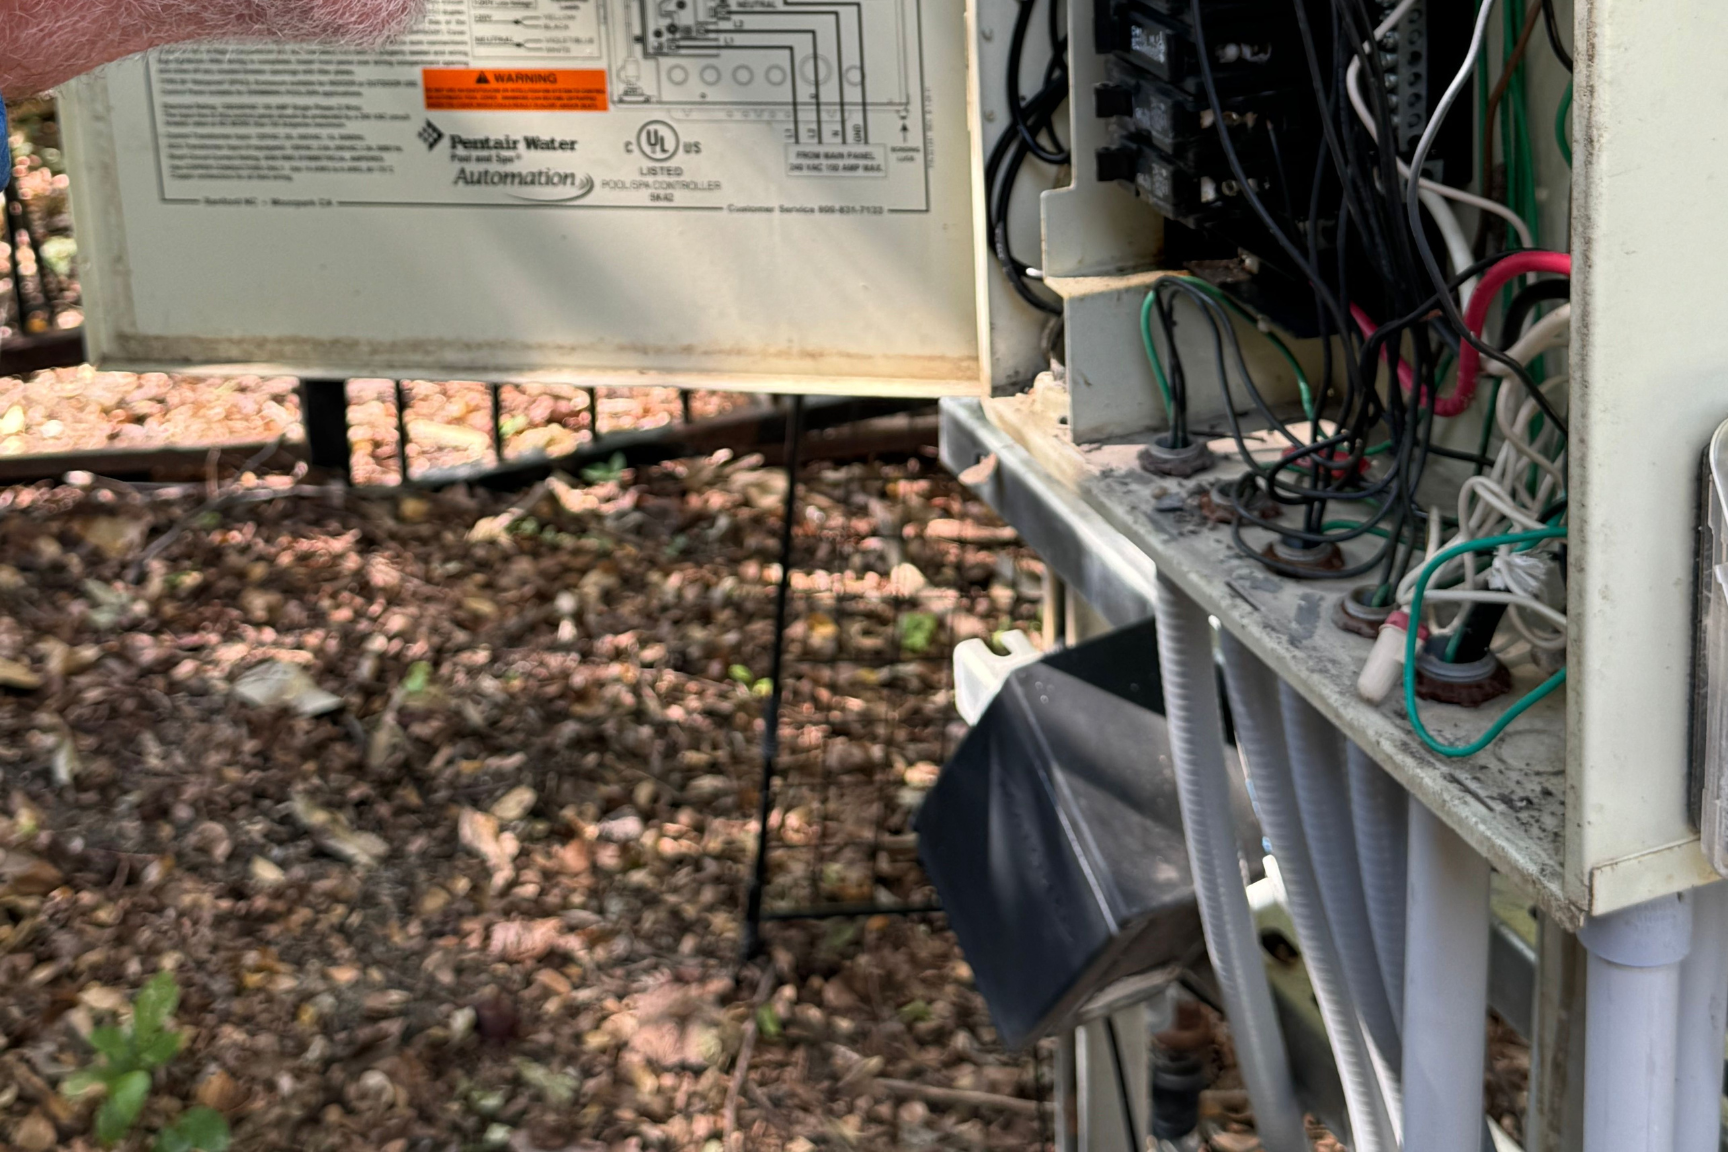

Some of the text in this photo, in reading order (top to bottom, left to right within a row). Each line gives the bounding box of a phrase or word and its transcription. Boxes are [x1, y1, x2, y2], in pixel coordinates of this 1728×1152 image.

[493, 72, 558, 84] WARNING
[449, 134, 578, 152] Pentair Water
[646, 129, 670, 154] UL
[683, 141, 702, 154] US
[453, 167, 576, 187] Automation
[639, 166, 683, 177] LISTED
[652, 181, 722, 191] CONTROLLER
[727, 203, 776, 214] Customer
[779, 204, 816, 214] Service
